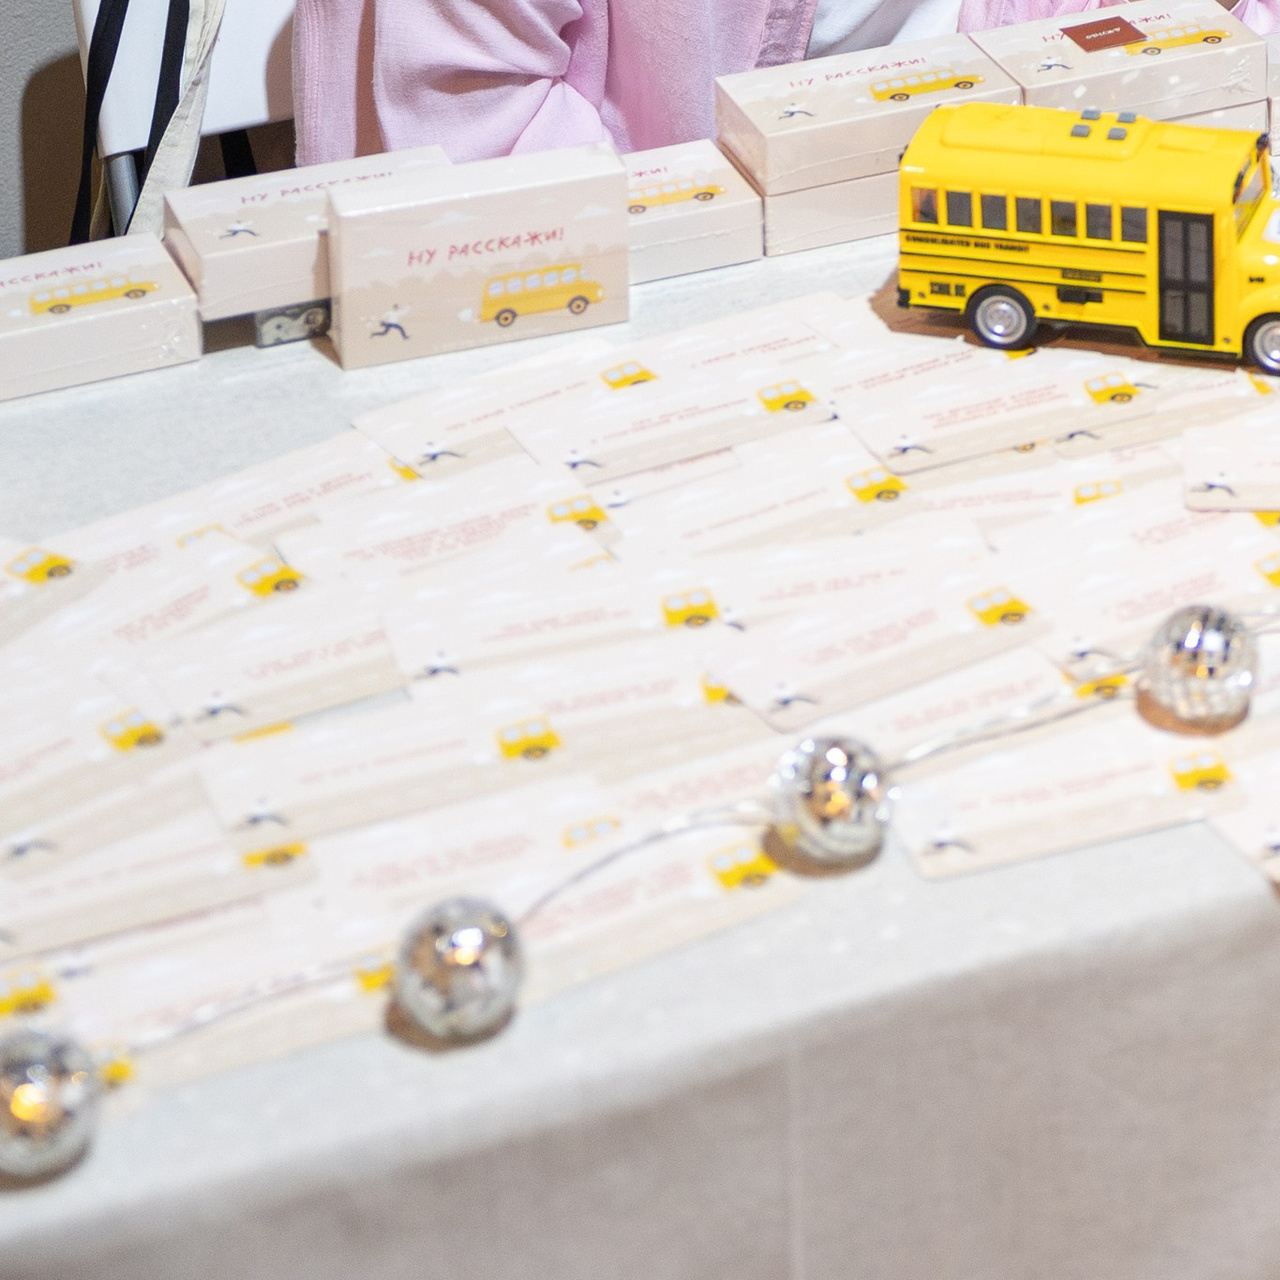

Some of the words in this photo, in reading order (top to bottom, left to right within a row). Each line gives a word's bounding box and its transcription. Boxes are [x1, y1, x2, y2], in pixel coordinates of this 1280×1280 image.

[790, 78, 814, 88] НУ
[825, 57, 926, 81] РАССКАЖИ!
[240, 193, 268, 204] НУ
[280, 171, 393, 197] РАССКАЖИ!
[408, 248, 437, 267] НУ
[448, 227, 565, 261] РАССКАЖИ!
